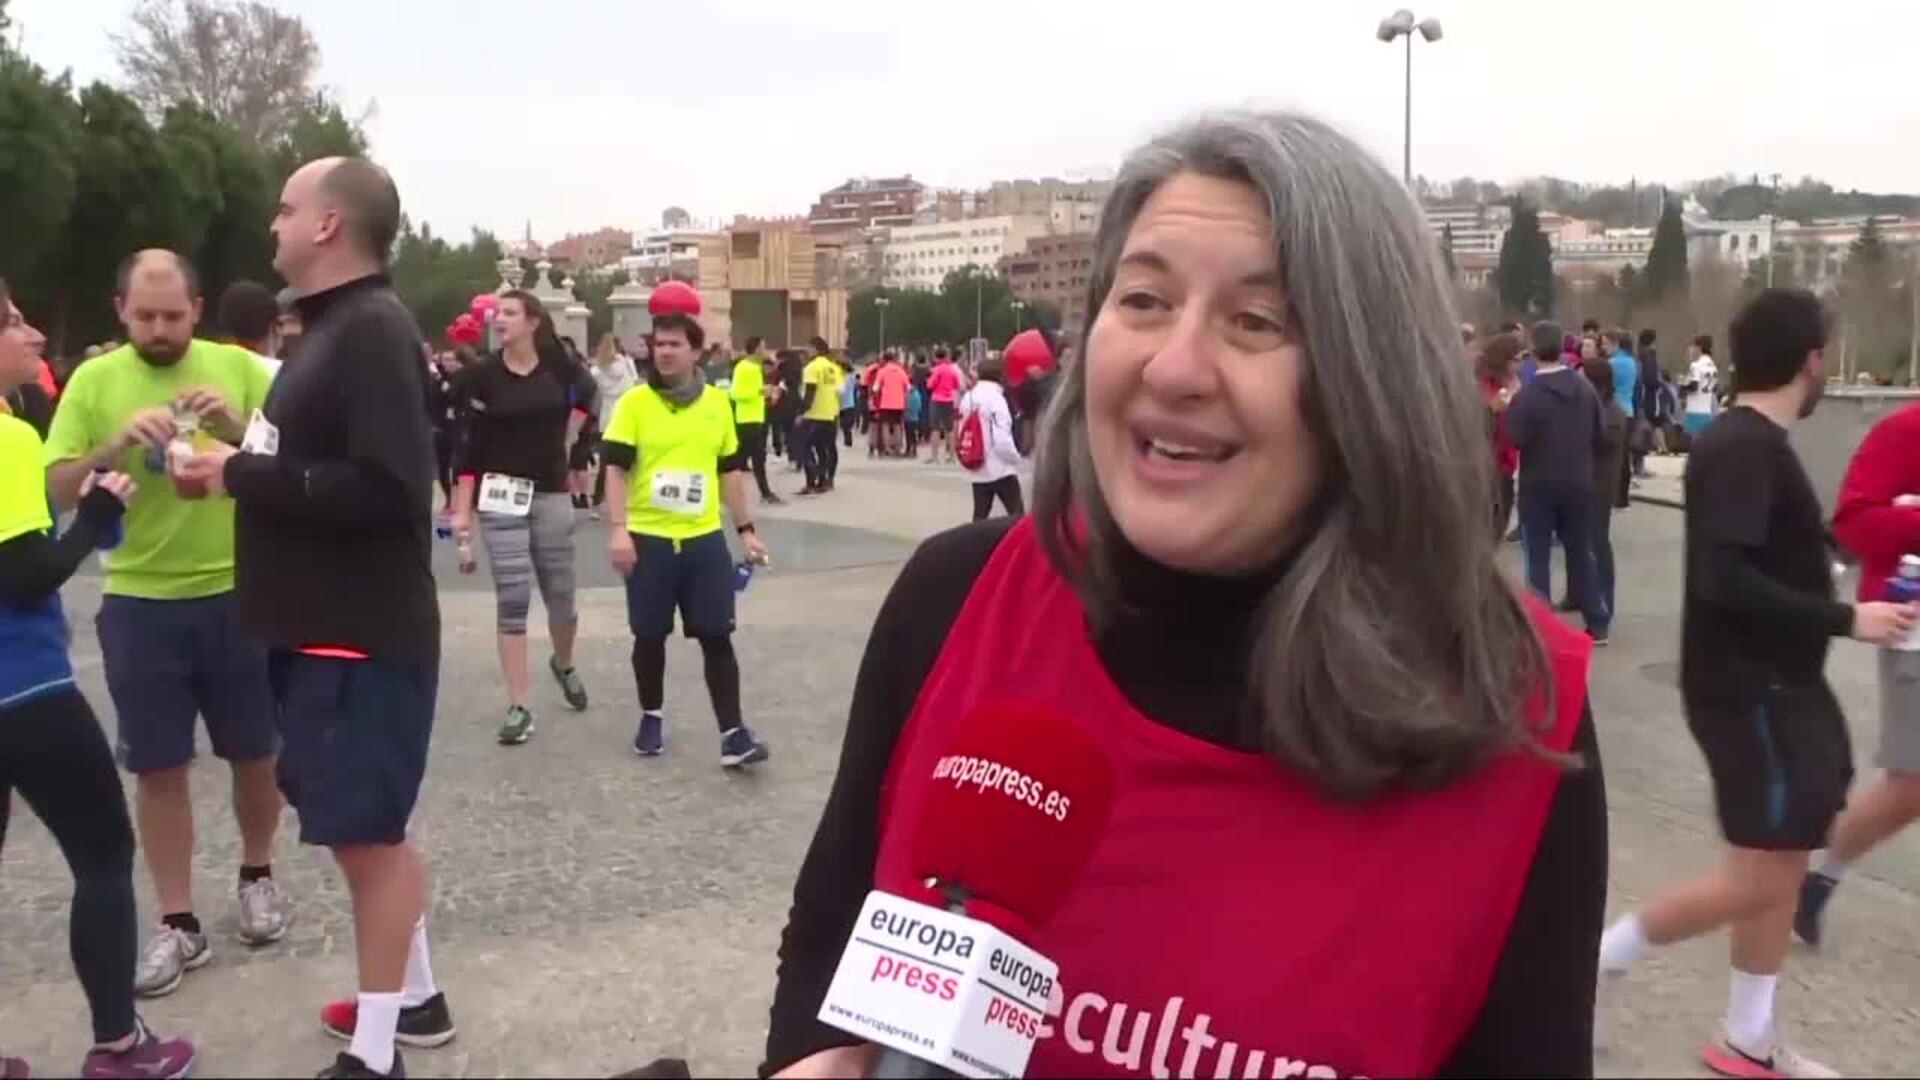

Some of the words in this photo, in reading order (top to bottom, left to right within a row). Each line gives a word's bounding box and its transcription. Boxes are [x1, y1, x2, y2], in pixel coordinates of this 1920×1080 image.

[932, 755, 1070, 821] europapress.es
[870, 908, 974, 958] europa
[871, 952, 960, 1001] press
[989, 947, 1053, 999] europa
[984, 996, 1039, 1040] press
